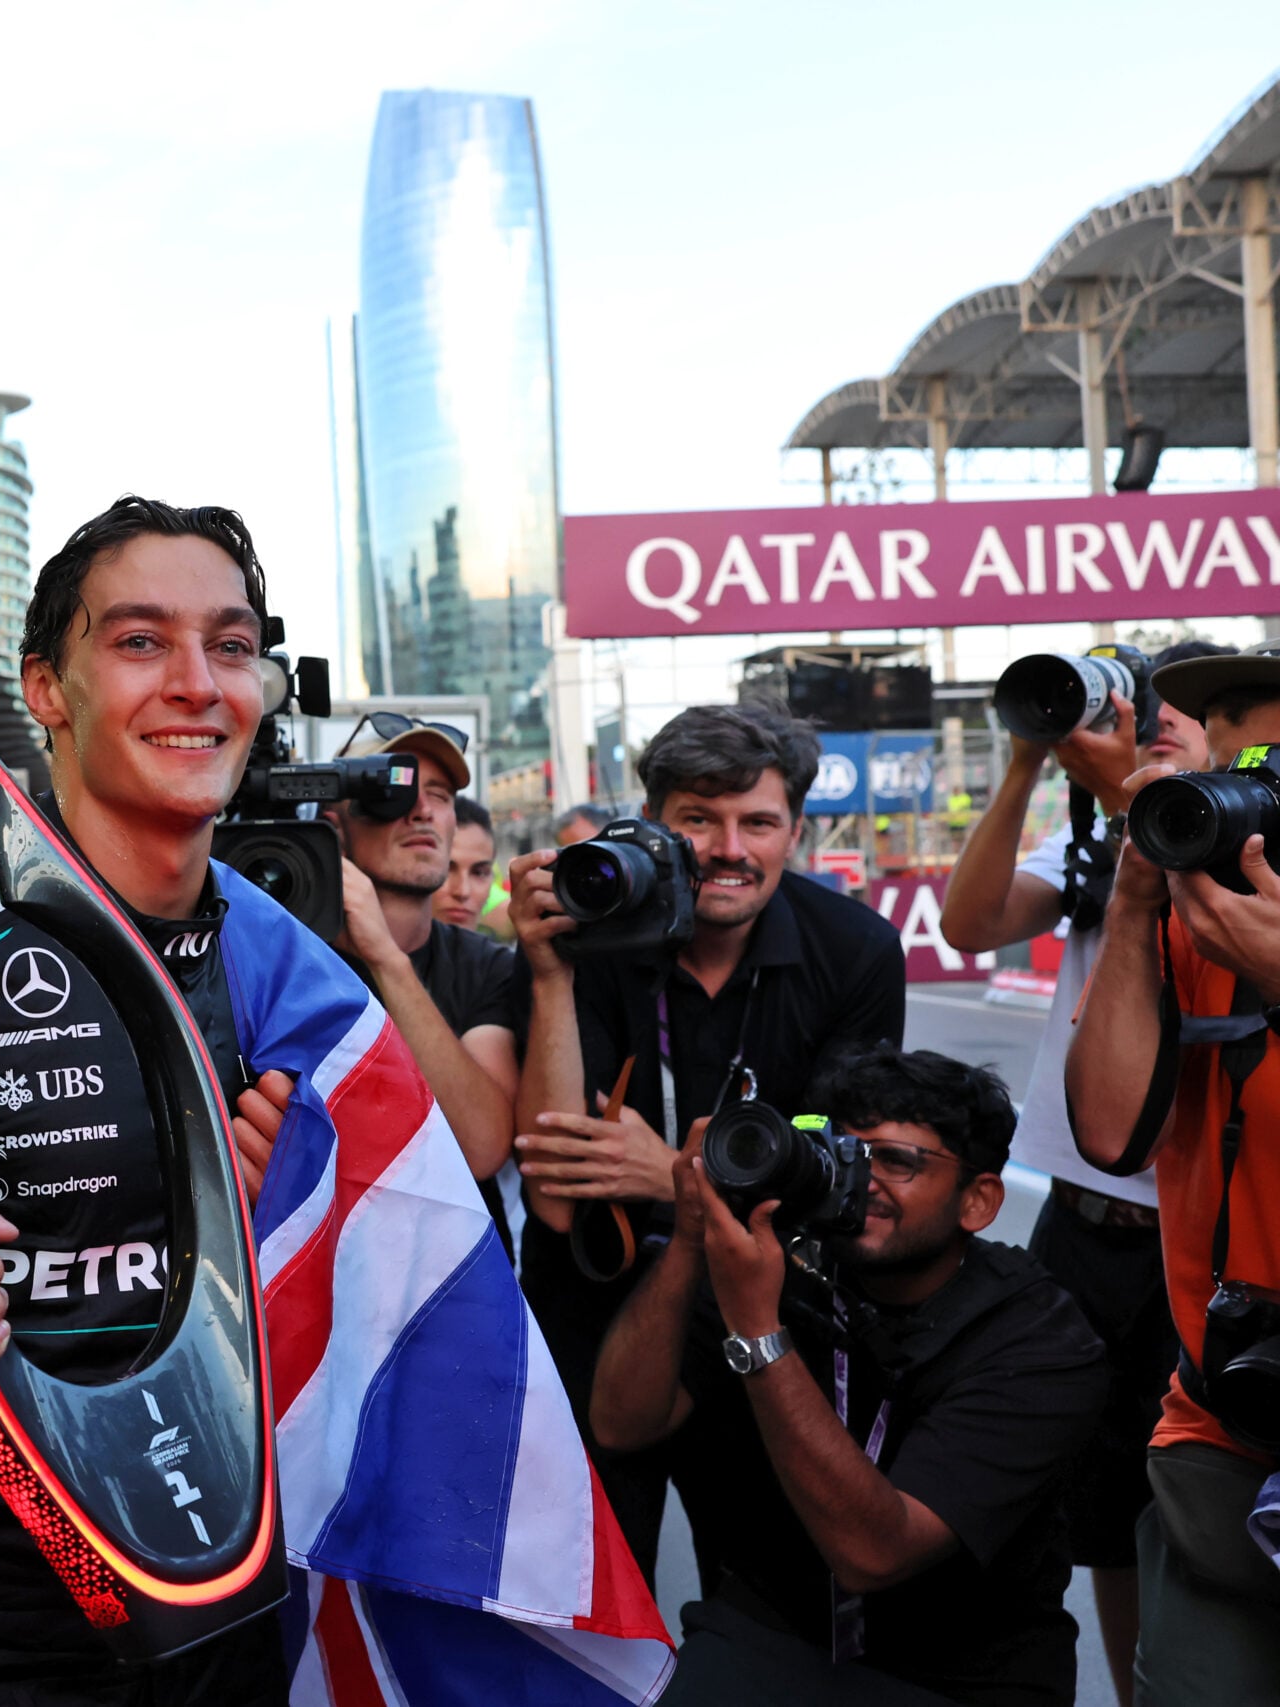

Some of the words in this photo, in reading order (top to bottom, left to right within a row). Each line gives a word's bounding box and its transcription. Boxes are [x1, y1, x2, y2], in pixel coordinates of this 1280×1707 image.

[625, 529, 937, 624] QATAR
[608, 827, 635, 837] Canon
[24, 1023, 101, 1044] AMG
[36, 1065, 104, 1100] UBS
[17, 1175, 118, 1198] Snapdragon
[153, 1453, 175, 1466] GRAND
